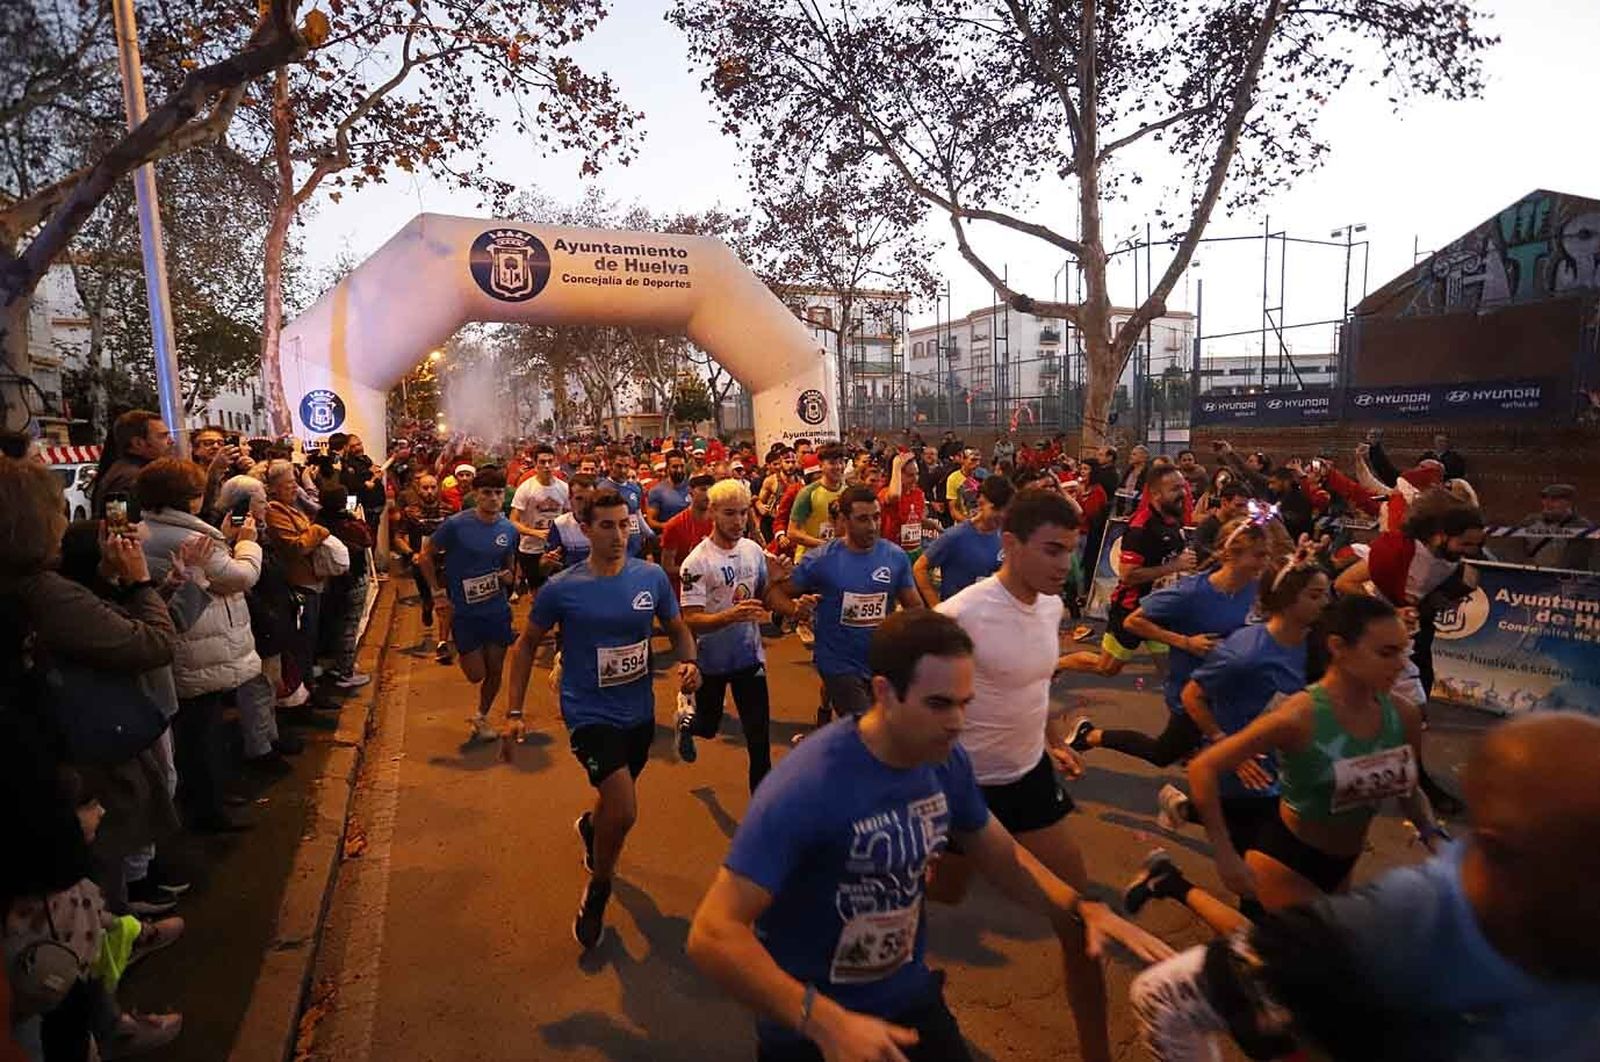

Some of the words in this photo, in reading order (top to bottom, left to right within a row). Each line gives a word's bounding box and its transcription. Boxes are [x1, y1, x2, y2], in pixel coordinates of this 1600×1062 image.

[553, 238, 688, 259] Ayuntamiento
[594, 256, 618, 272] de
[625, 257, 689, 275] Huelva
[625, 276, 639, 286] de
[643, 277, 692, 289] Deportes
[1375, 393, 1431, 404] HYUNDAI
[1473, 387, 1541, 400] HYUNDAI
[1218, 402, 1257, 410] HYUNDAI
[1285, 398, 1329, 408] HYUNDAI
[861, 603, 882, 617] 595
[622, 653, 645, 673] 594
